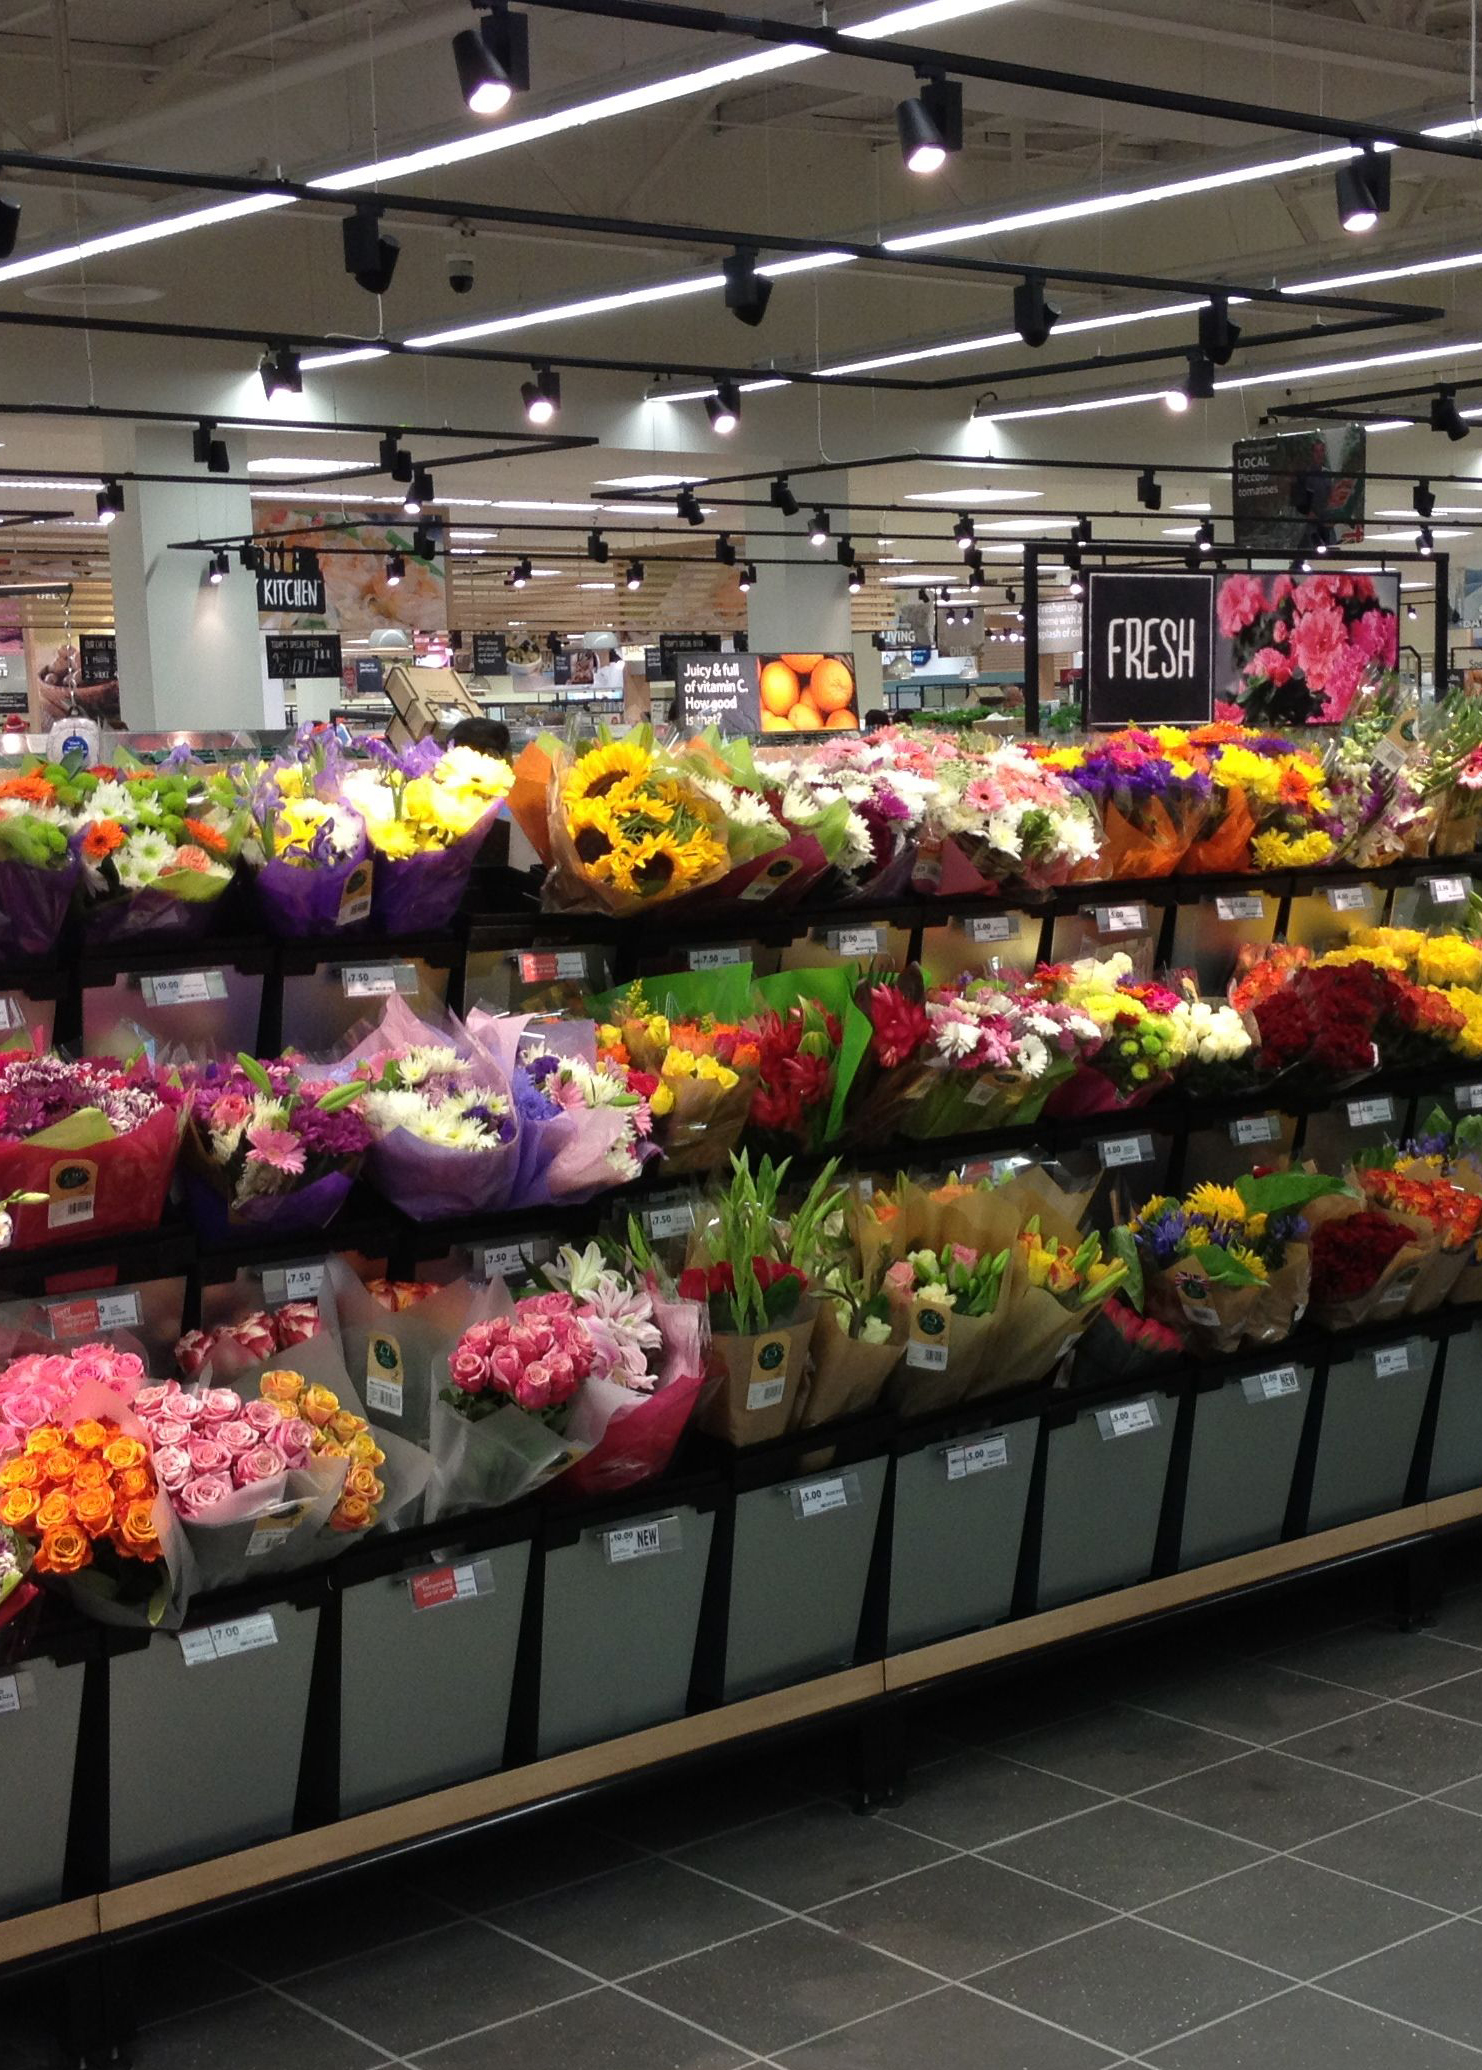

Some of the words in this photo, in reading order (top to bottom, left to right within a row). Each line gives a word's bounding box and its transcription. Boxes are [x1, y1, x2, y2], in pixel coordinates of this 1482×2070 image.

[1237, 455, 1270, 469] LOCAL
[1238, 486, 1279, 497] tomatoes
[264, 579, 318, 606] KITCHEN
[1108, 617, 1195, 679] FRESH
[683, 663, 712, 680] Juicy
[712, 663, 722, 677] &
[722, 662, 740, 677] full
[684, 680, 697, 693] of
[696, 680, 736, 693] vitamin
[736, 678, 749, 693] C.
[684, 696, 708, 710] How
[707, 695, 738, 712] good
[685, 713, 694, 726] is
[652, 1213, 672, 1227] £7.50
[486, 1252, 507, 1266] £7.50
[287, 1272, 311, 1285] £7.50
[636, 1529, 657, 1549] NEW
[213, 1625, 241, 1642] £7.00
